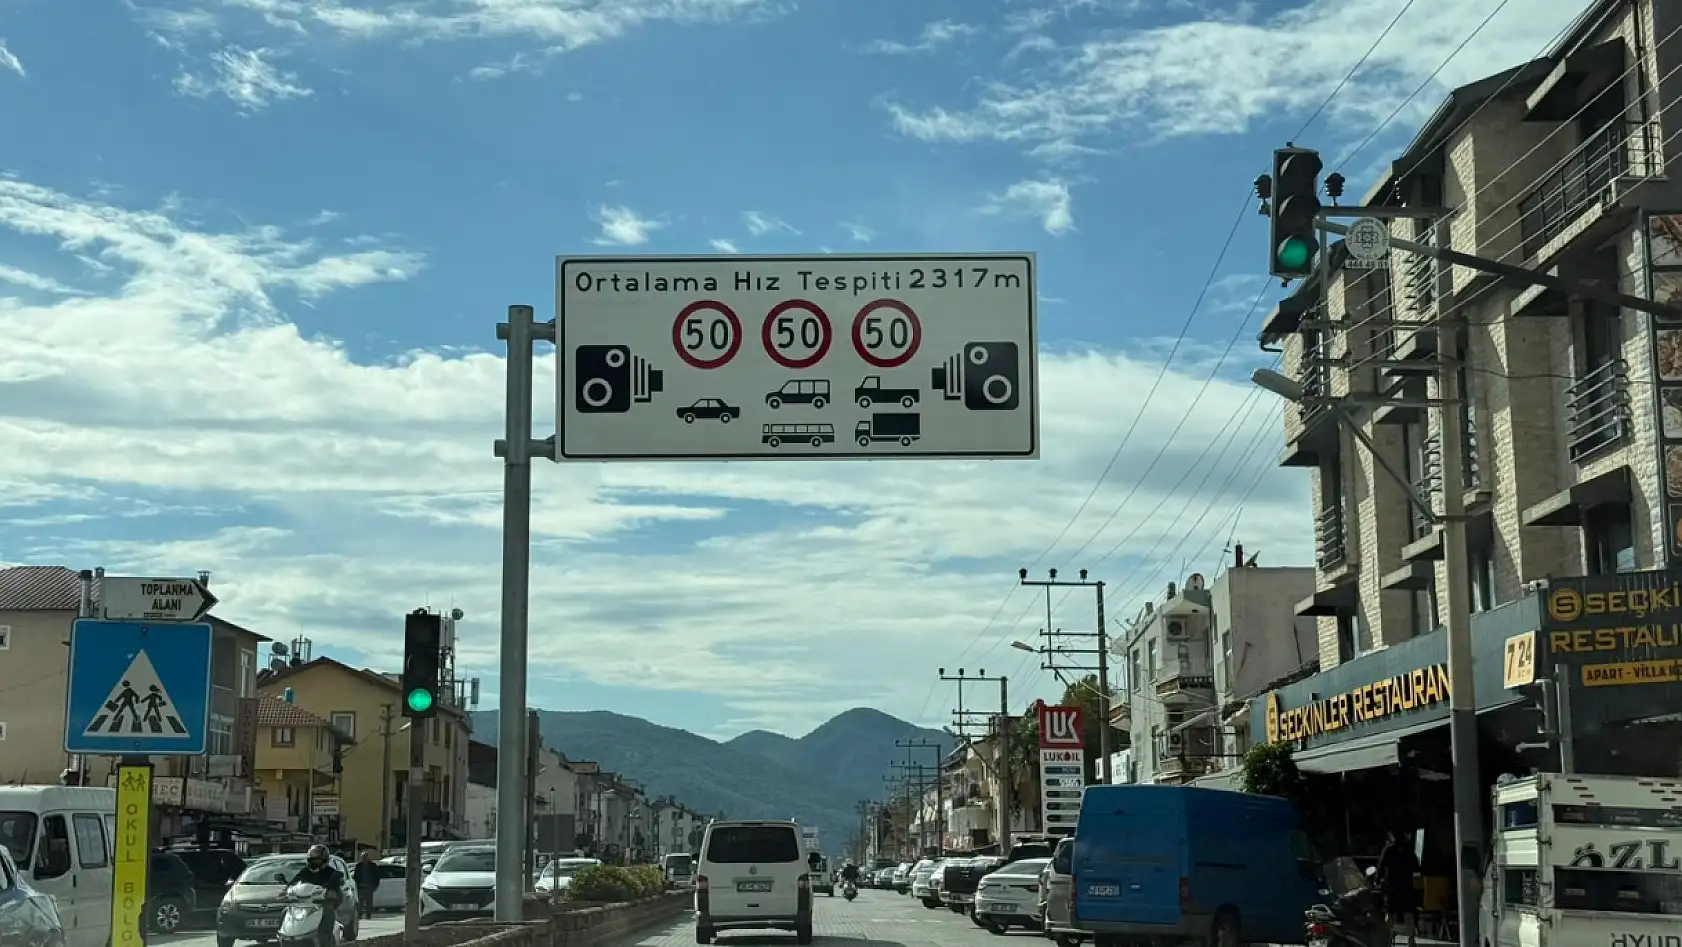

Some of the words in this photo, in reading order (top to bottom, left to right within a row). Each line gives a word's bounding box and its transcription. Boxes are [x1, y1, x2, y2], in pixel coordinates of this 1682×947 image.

[575, 271, 718, 292] Ortalama
[734, 271, 781, 291] Hız
[797, 271, 901, 297] Tespiti
[686, 318, 730, 350] 50
[777, 317, 820, 350] 50
[865, 317, 909, 349] 50
[140, 583, 194, 596] TOPLANMA
[151, 598, 182, 611] ALANI
[1550, 623, 1682, 654] RESTAU
[1586, 667, 1624, 682] APART
[1353, 663, 1451, 722] RESTAURAN
[125, 803, 138, 863] OKUL
[121, 880, 135, 947] BÖLG
